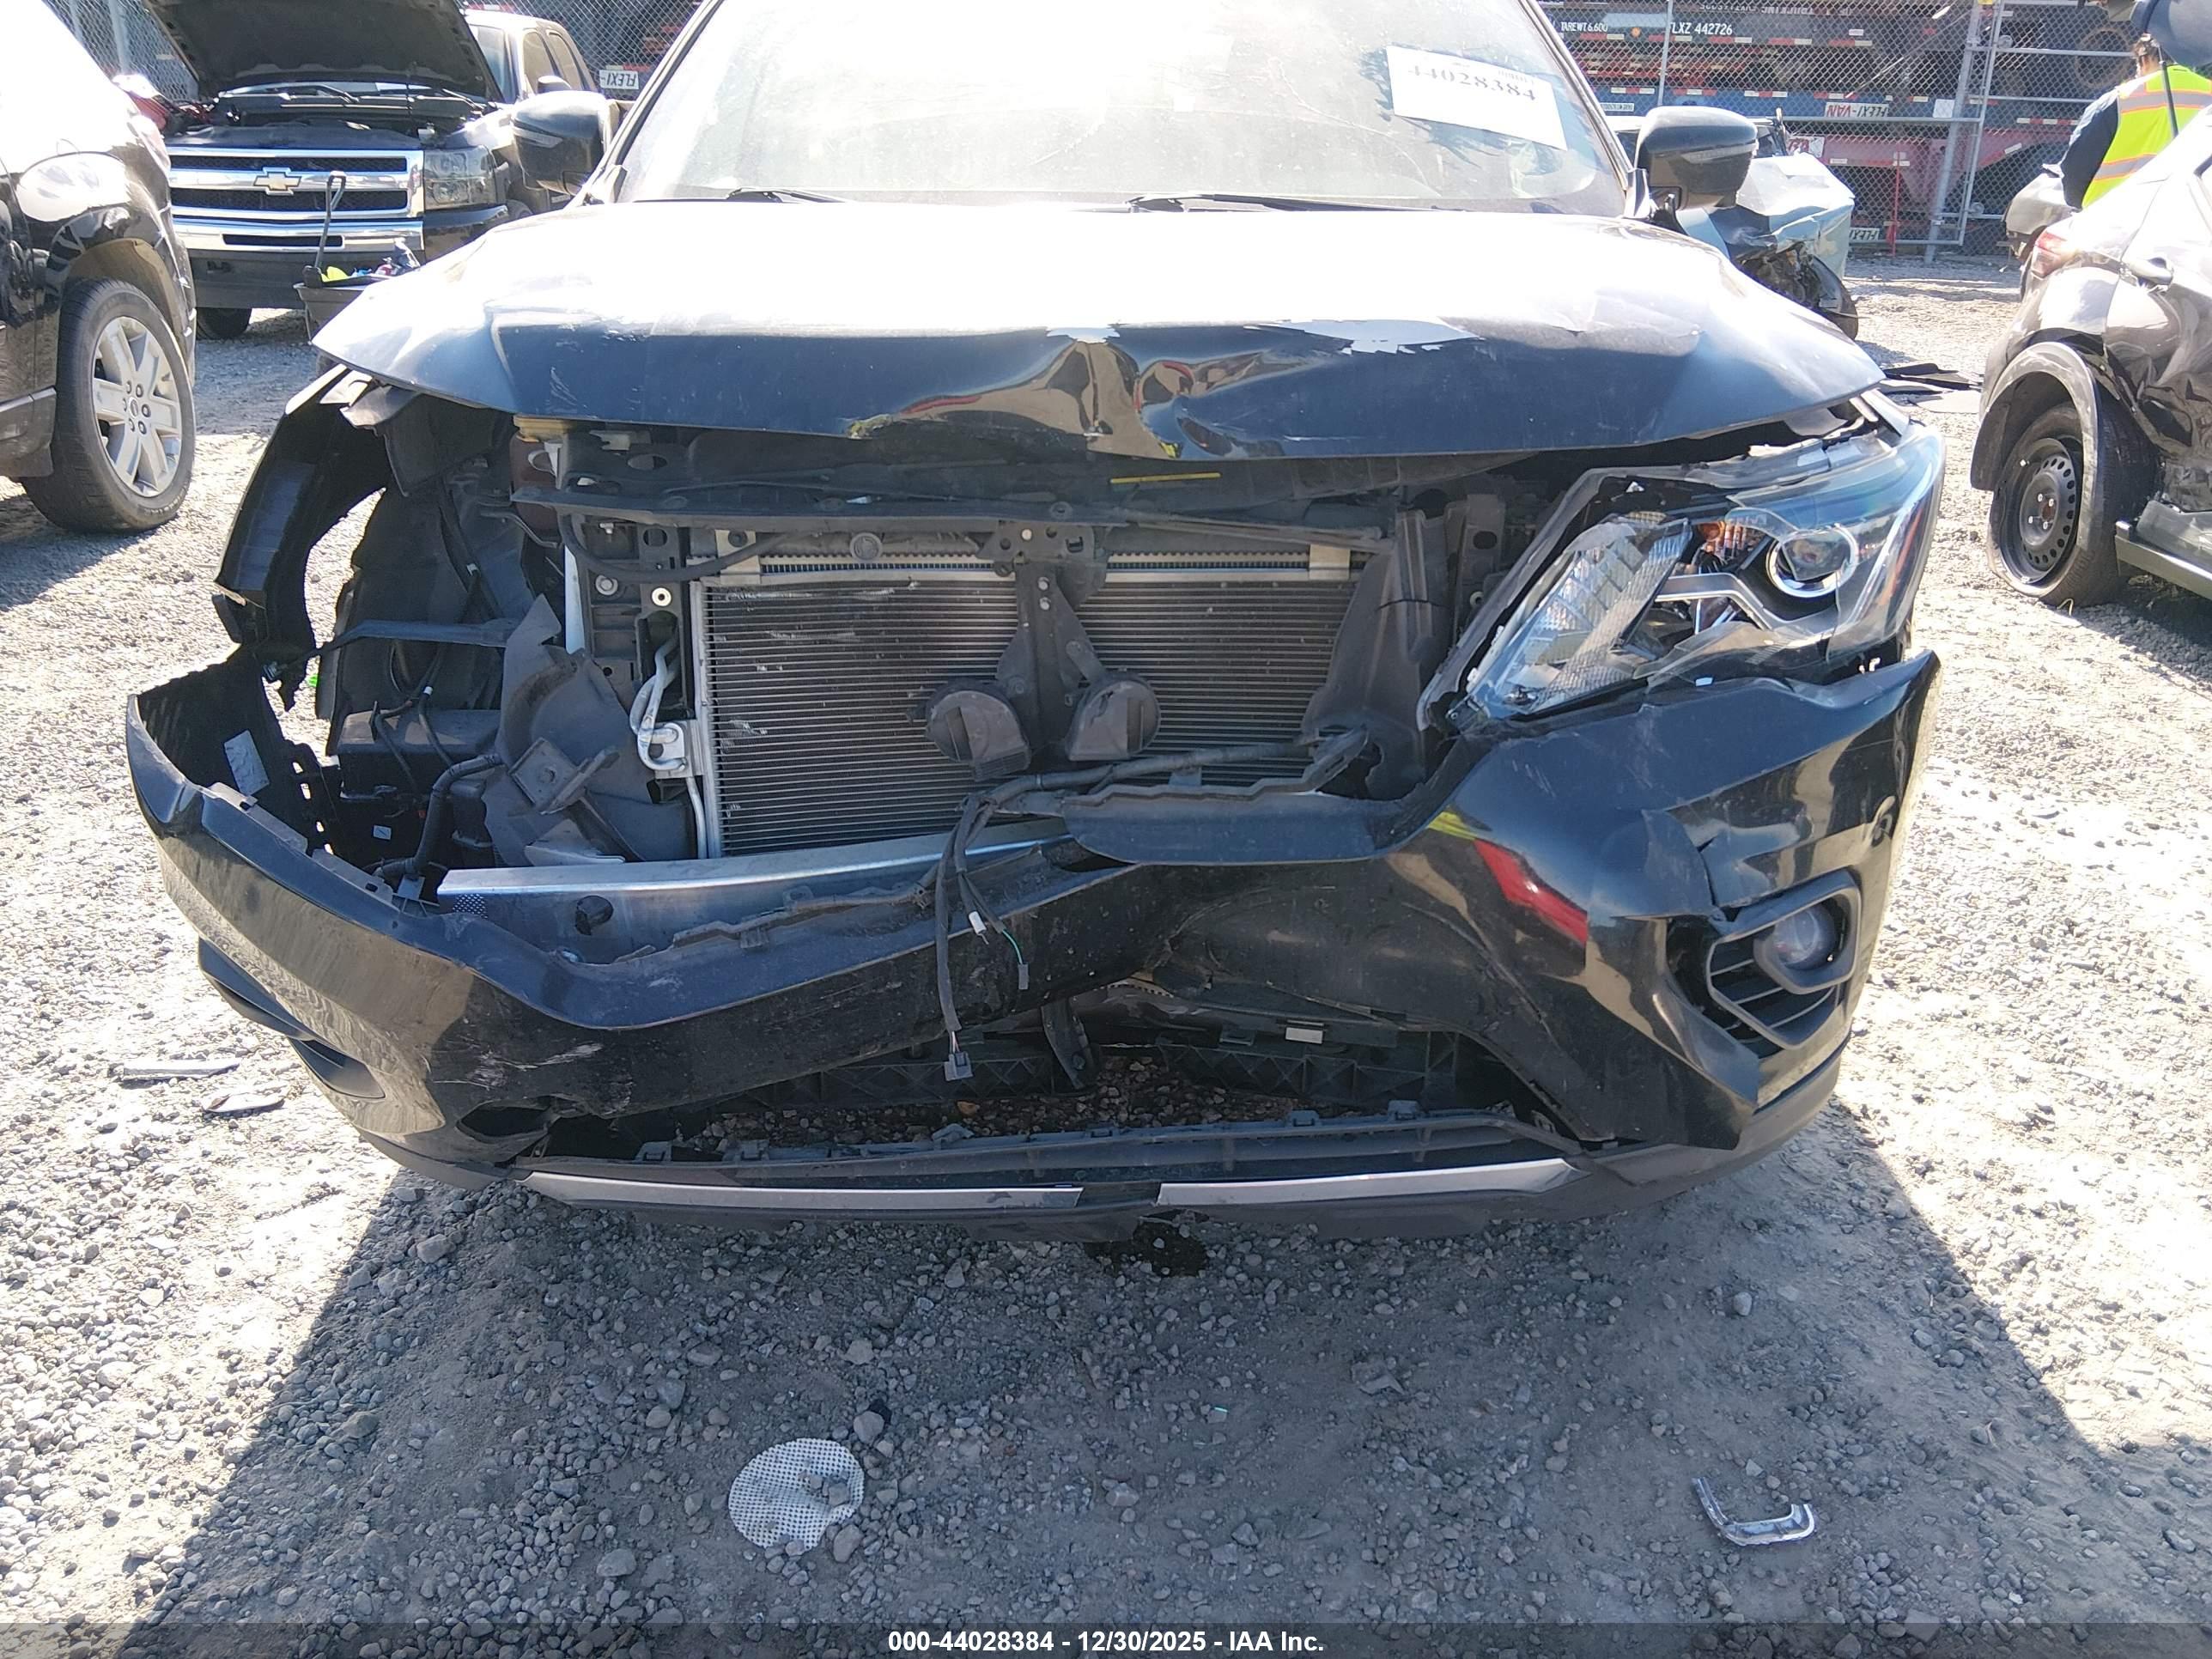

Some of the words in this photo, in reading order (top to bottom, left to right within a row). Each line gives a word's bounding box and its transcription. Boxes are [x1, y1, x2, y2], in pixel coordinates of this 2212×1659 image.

[1694, 22, 1733, 35] 442726
[1407, 65, 1535, 101] 44028384
[1826, 105, 1887, 118] FLEXI-VAN
